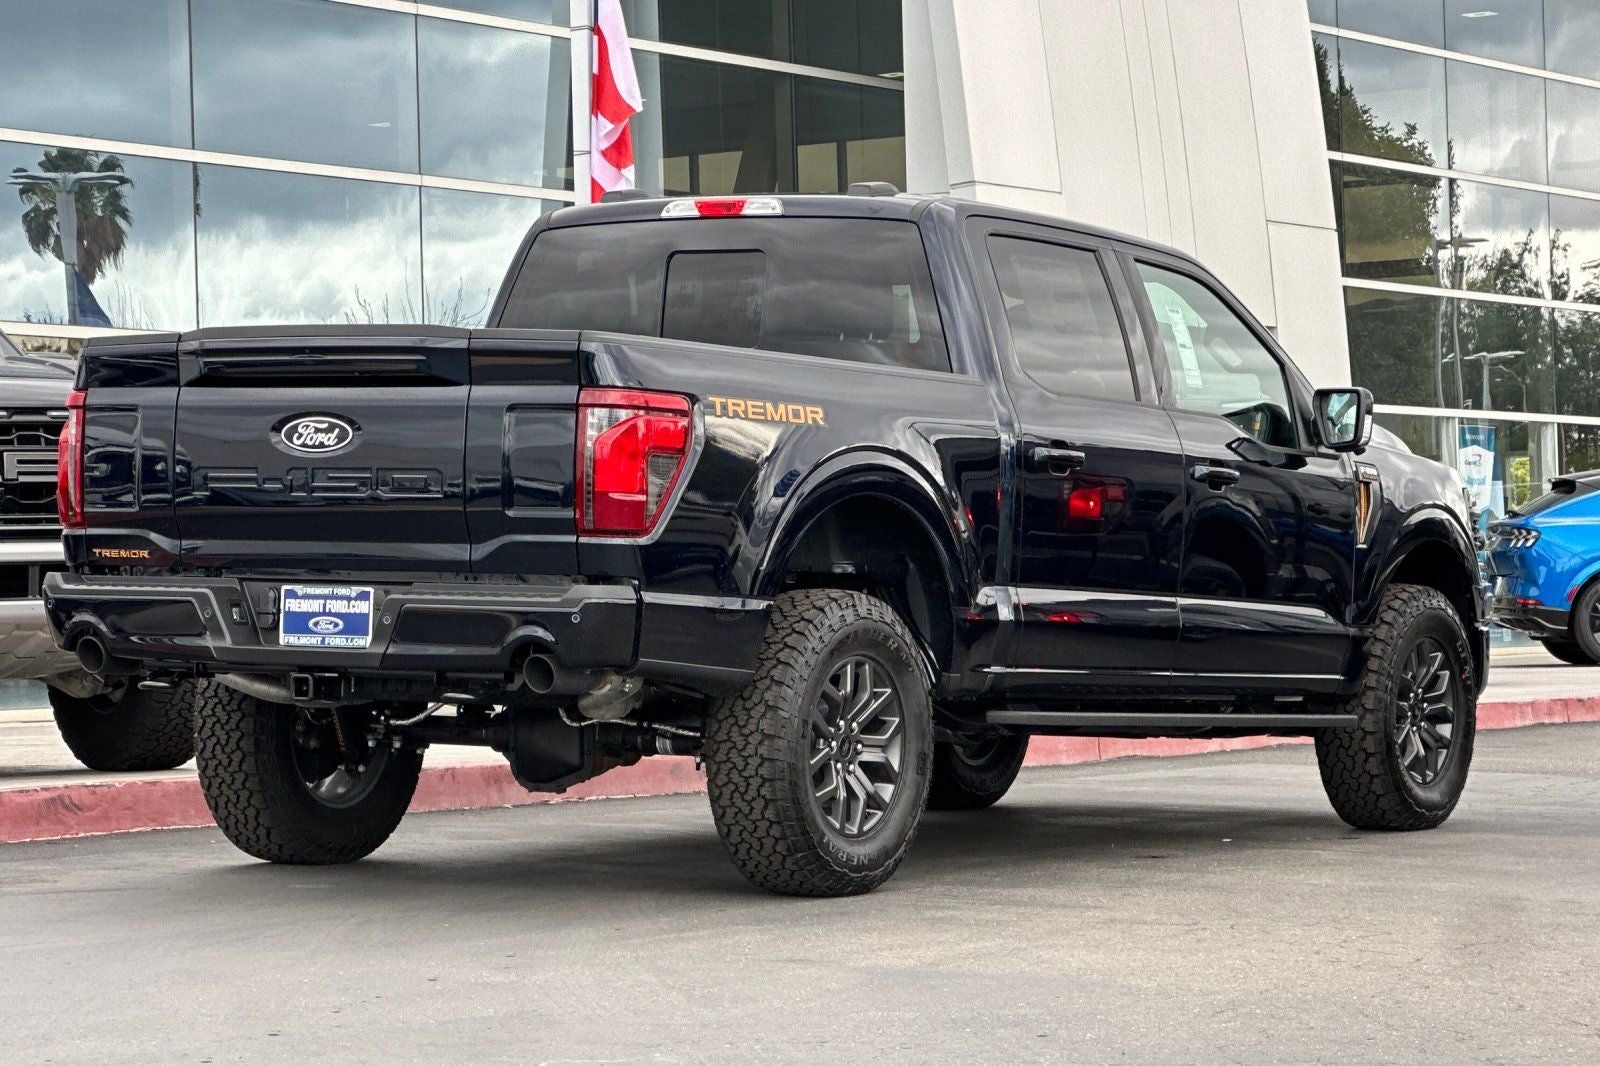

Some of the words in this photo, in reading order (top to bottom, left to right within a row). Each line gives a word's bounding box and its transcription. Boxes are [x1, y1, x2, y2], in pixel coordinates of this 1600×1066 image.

[708, 396, 825, 426] TREMOR
[293, 421, 340, 446] Ford
[192, 467, 444, 499] F-150
[92, 548, 150, 558] TREMOR
[303, 587, 334, 595] FREMONT
[334, 588, 351, 596] FORD
[285, 599, 324, 612] FREMONT
[326, 600, 369, 613] FORD.COM
[284, 637, 322, 645] FREMONT
[325, 638, 366, 646] FORD.COM
